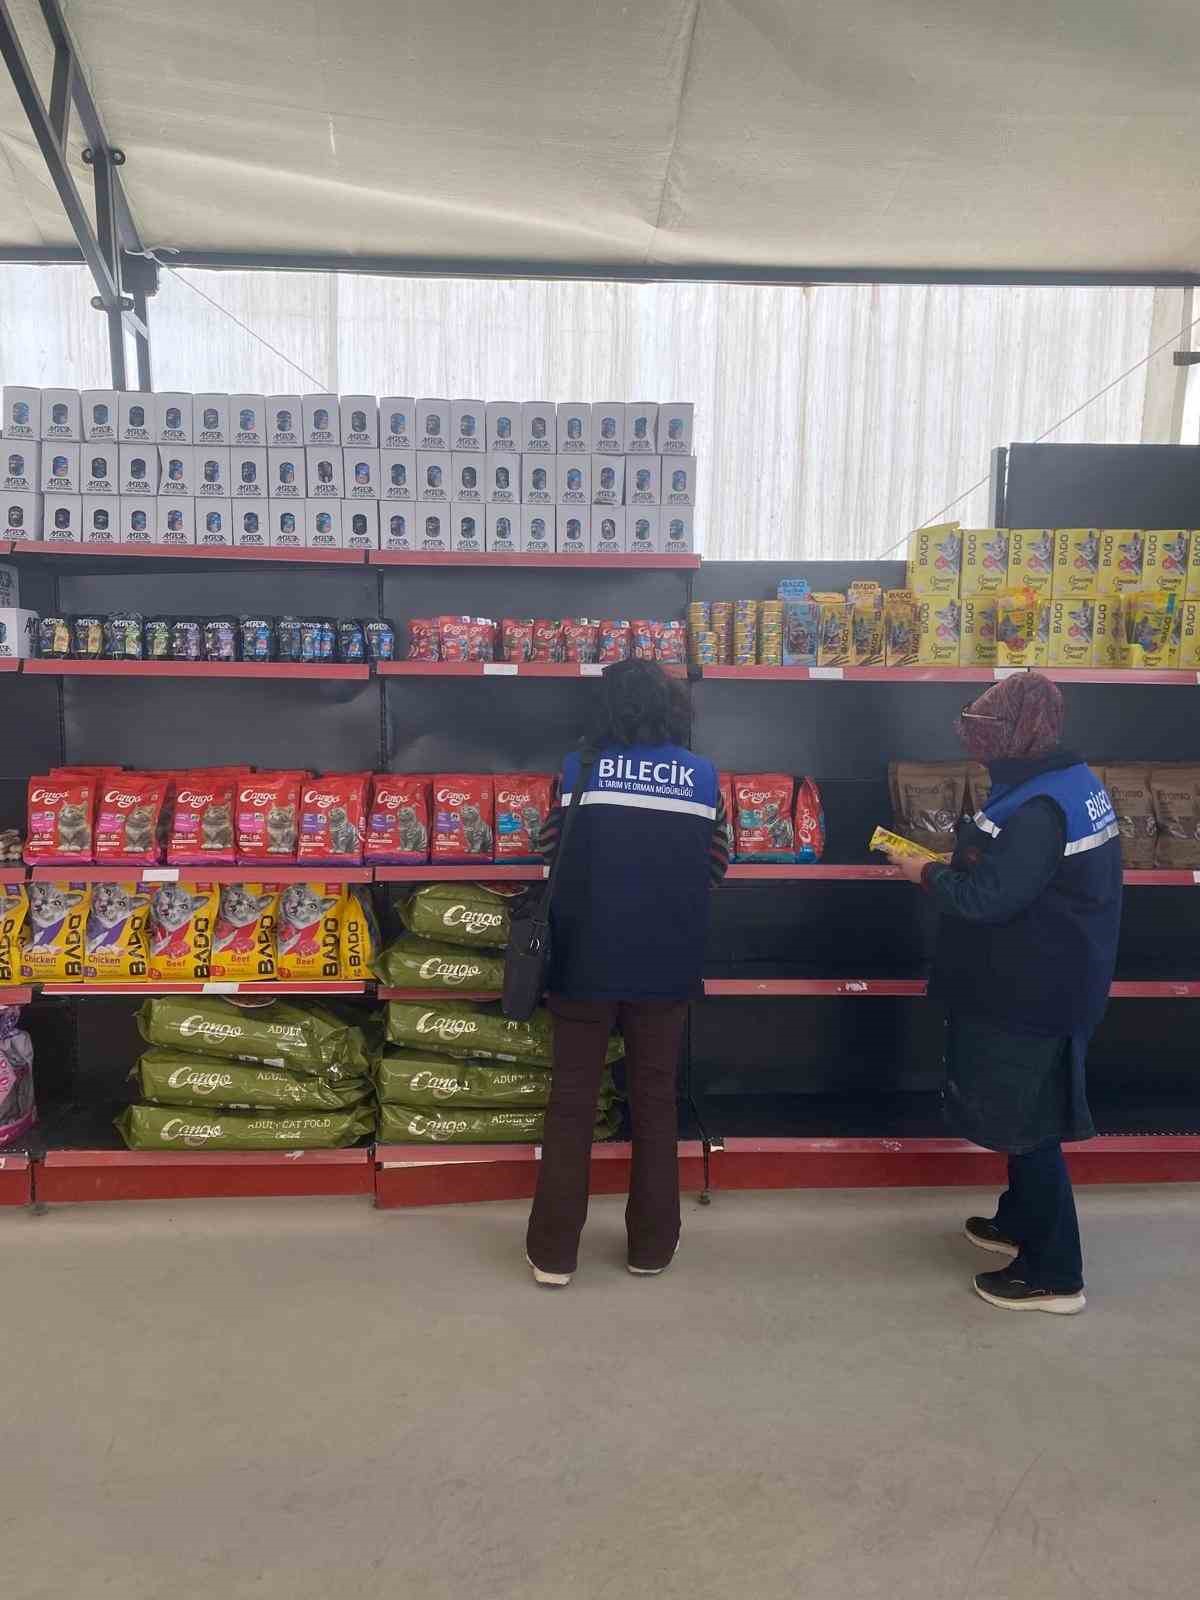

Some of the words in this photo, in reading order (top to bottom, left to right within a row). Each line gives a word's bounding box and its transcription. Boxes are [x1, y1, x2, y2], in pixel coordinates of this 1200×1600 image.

[919, 535, 928, 566] BADO
[967, 534, 976, 565] BADO
[1013, 534, 1022, 565] BADO
[1058, 534, 1069, 566] BADO
[1103, 536, 1113, 567] BADO
[1147, 535, 1157, 566] BADO
[1053, 603, 1063, 634] BADO
[599, 755, 695, 787] BİLECİK
[31, 789, 69, 805] Cango
[105, 790, 143, 807] Cango
[177, 791, 214, 808] Cango
[240, 789, 277, 806] Cango
[304, 790, 340, 807] Cango
[377, 791, 408, 808] Cango
[437, 789, 470, 806] Cango
[498, 791, 530, 807] Cango
[605, 780, 623, 789] TARIM
[624, 781, 631, 790] VE
[632, 783, 654, 793] ORMAN
[739, 789, 770, 804] Cango
[443, 905, 502, 934] Cango
[64, 915, 82, 976] BADO
[128, 916, 146, 976] BADO
[193, 917, 210, 978] BADO
[257, 915, 274, 975] BADO
[322, 917, 339, 977] BADO
[348, 921, 361, 967] BADO
[24, 953, 56, 965] Chicken
[88, 954, 120, 965] Chicken
[166, 959, 186, 967] Beef
[419, 957, 480, 984] Cango
[267, 1024, 302, 1036] ADULT
[416, 1011, 478, 1040] Cango
[168, 1066, 233, 1095] Cango
[248, 1119, 281, 1129] ADULT
[282, 1119, 302, 1129] CAT
[303, 1119, 332, 1129] FOOD
